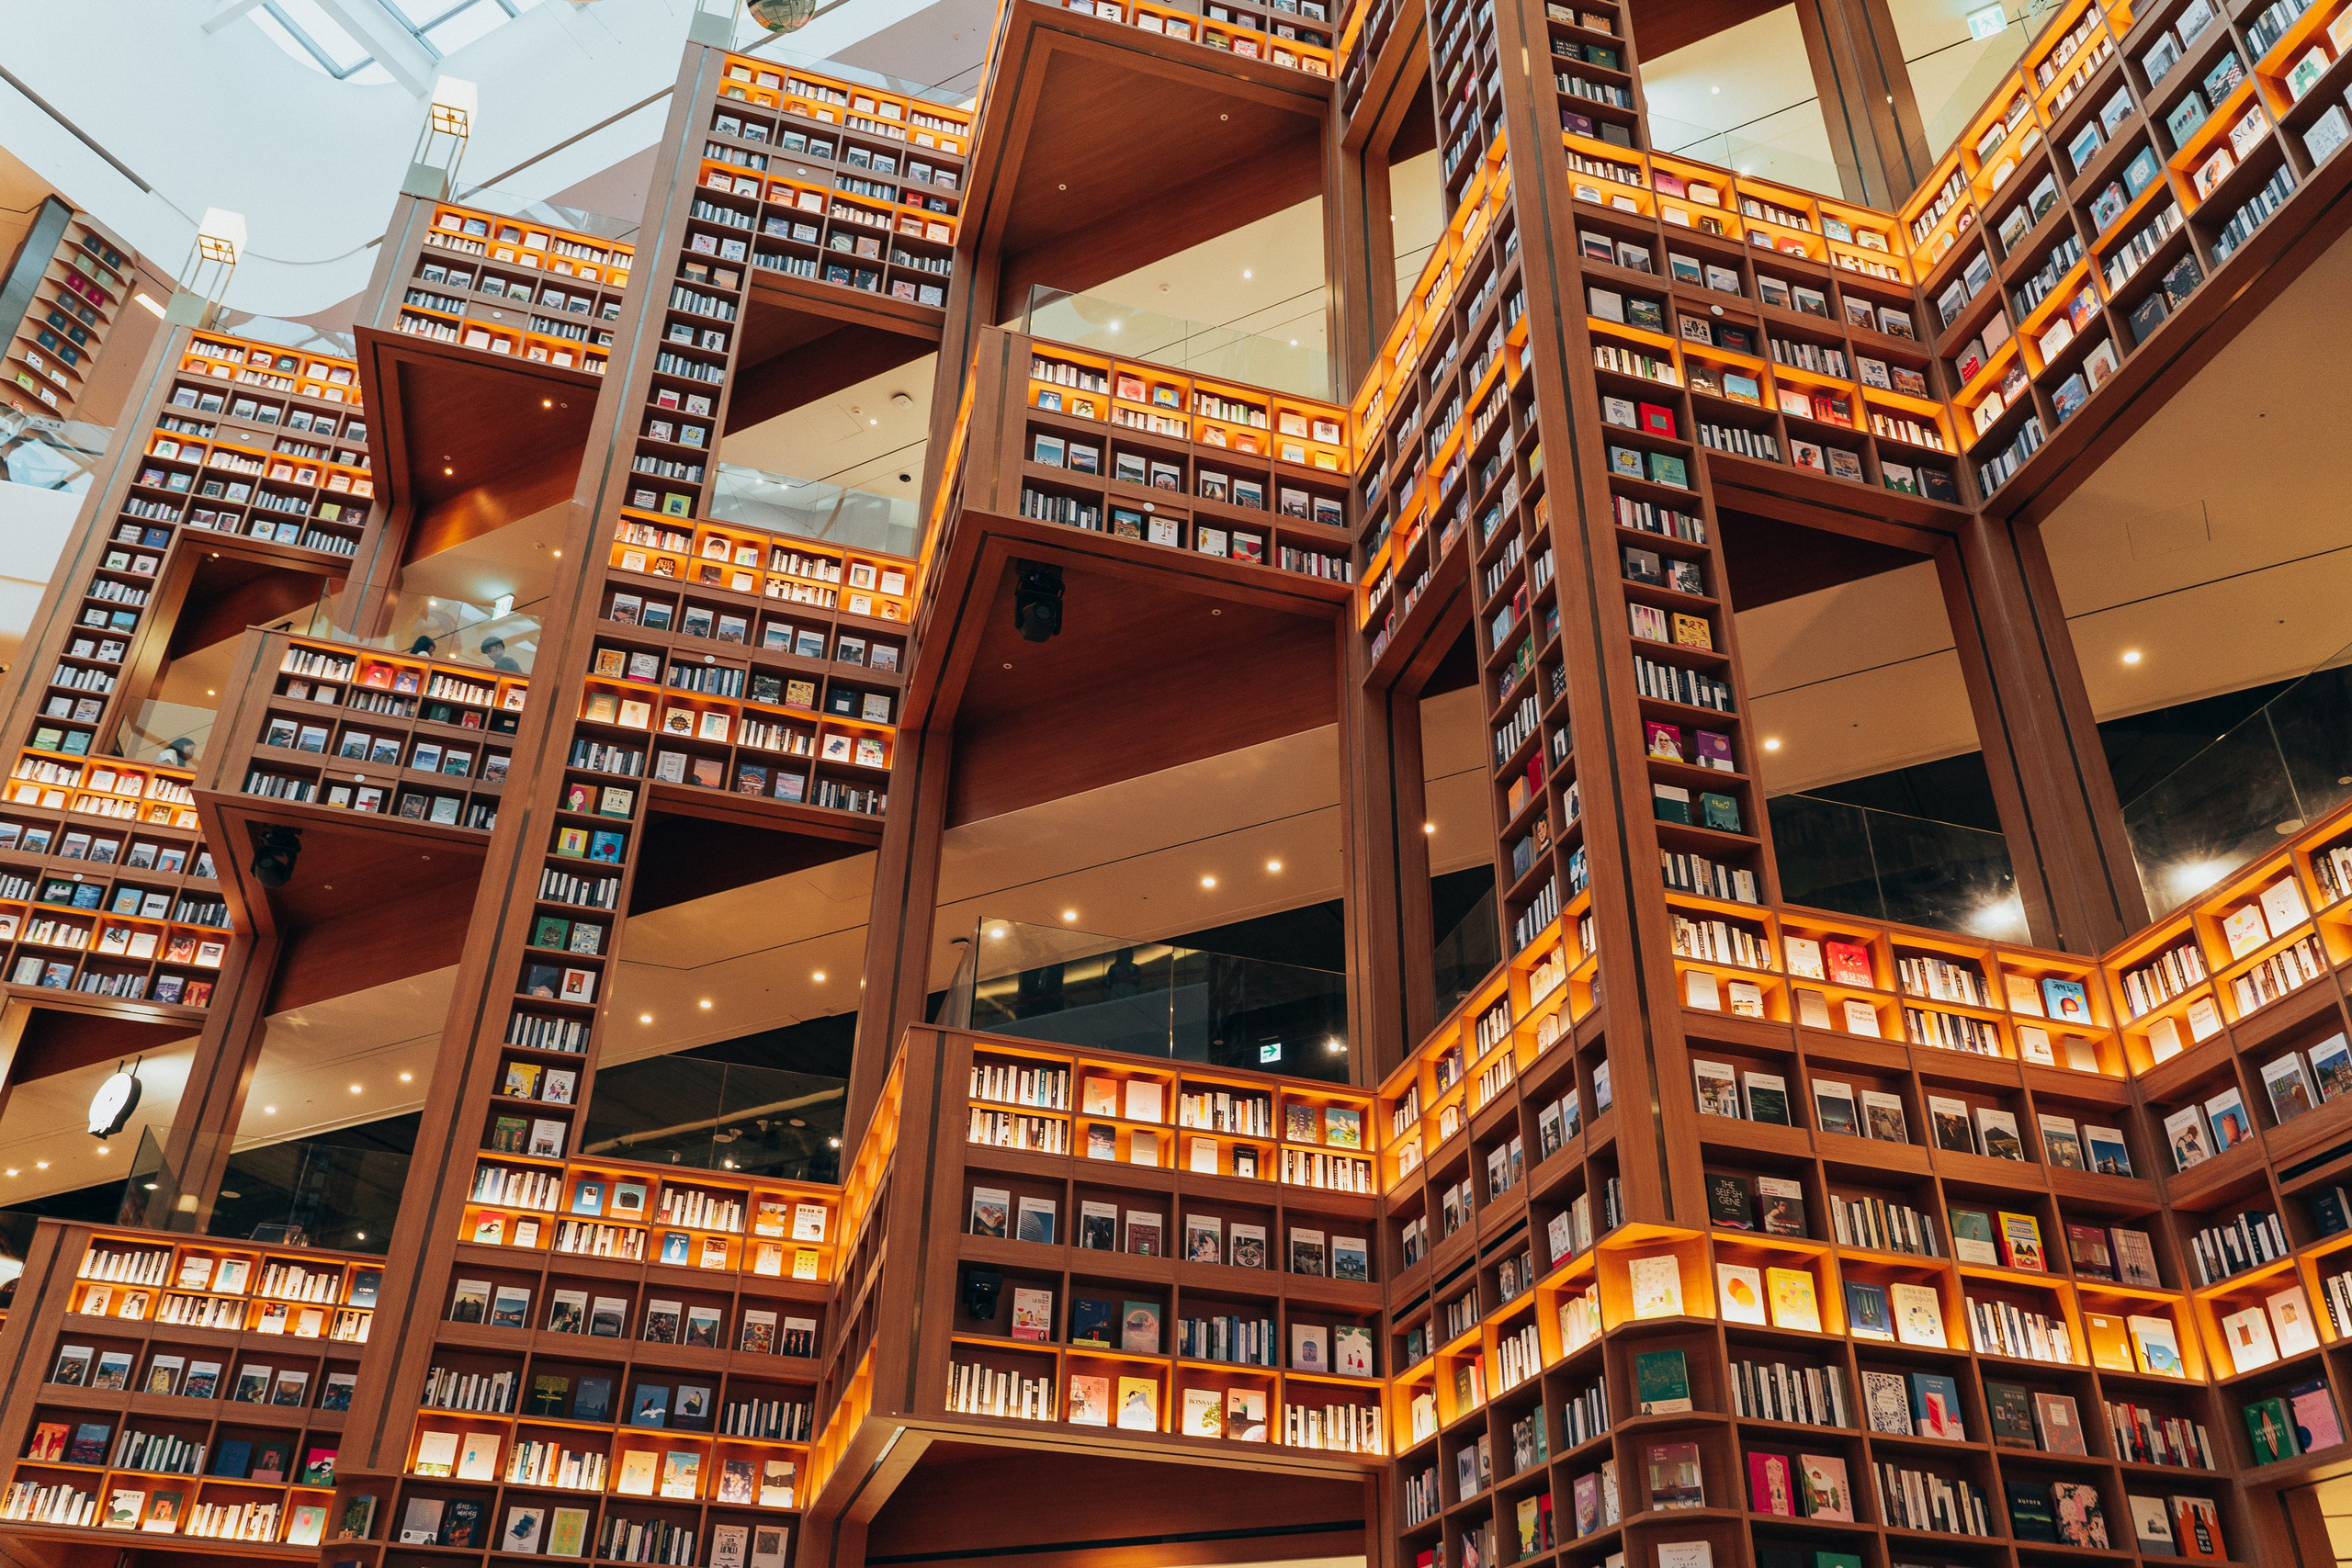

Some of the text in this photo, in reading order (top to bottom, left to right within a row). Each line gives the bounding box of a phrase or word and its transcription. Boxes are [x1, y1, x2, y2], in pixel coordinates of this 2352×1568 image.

[1851, 1008, 1872, 1016] Original
[2192, 1006, 2210, 1018] Original
[1851, 1014, 1874, 1023] Features
[2193, 1013, 2212, 1025] Features
[1720, 1180, 1735, 1190] THE
[1715, 1187, 1743, 1199] SELFSH
[1719, 1196, 1741, 1207] GENE
